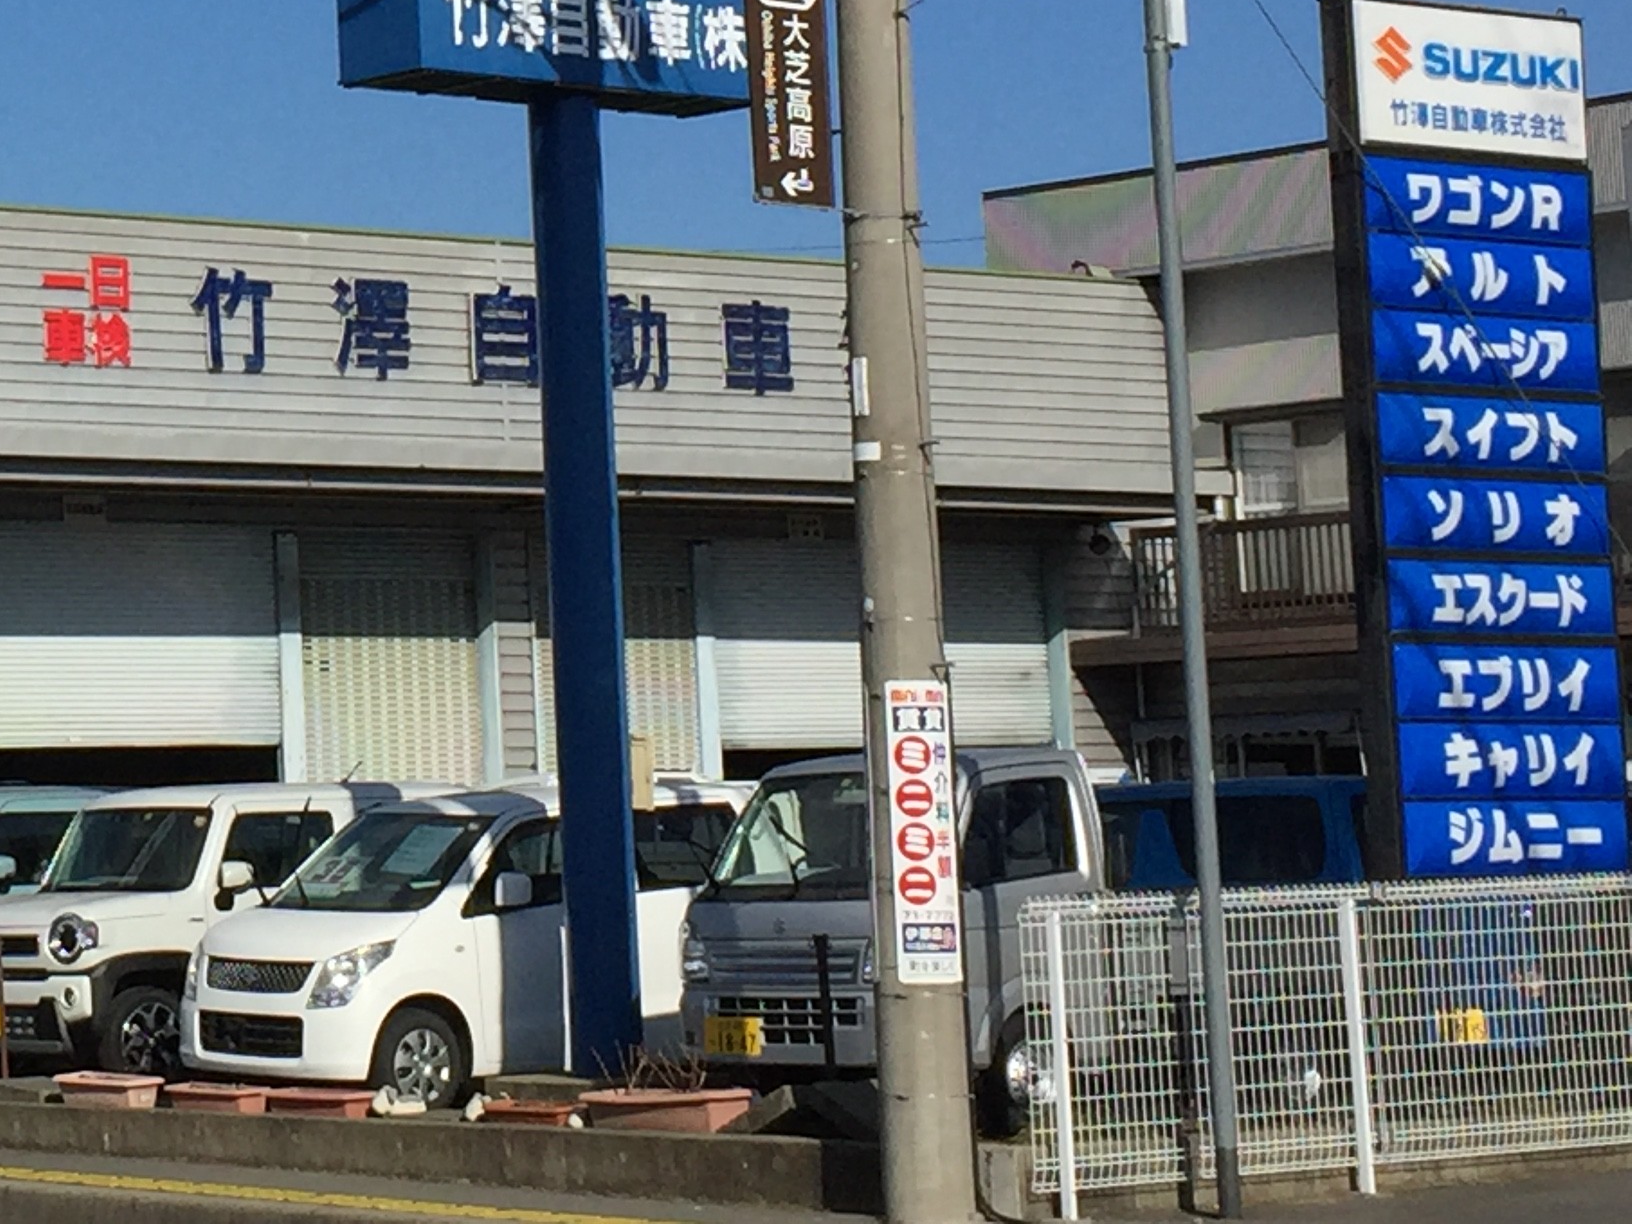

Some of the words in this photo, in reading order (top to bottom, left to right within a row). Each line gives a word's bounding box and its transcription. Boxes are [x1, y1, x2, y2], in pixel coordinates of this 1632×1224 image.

[782, 13, 816, 159] 大芝高原
[1423, 40, 1579, 90] SUZUKI
[1390, 98, 1567, 142] 竹澤自動車株式会社
[1406, 172, 1564, 231] ワゴンR
[42, 256, 129, 311] 一日
[1410, 245, 1566, 305] アルト
[42, 308, 131, 368] 車検
[1416, 322, 1567, 380] スペーシア
[1422, 406, 1577, 463] スイフト
[1427, 489, 1581, 545] ソリオ
[1432, 573, 1587, 627] エスクード
[1439, 656, 1591, 712] エブリイ
[1443, 732, 1595, 788] キャリイ
[1448, 808, 1603, 865] ジムニー
